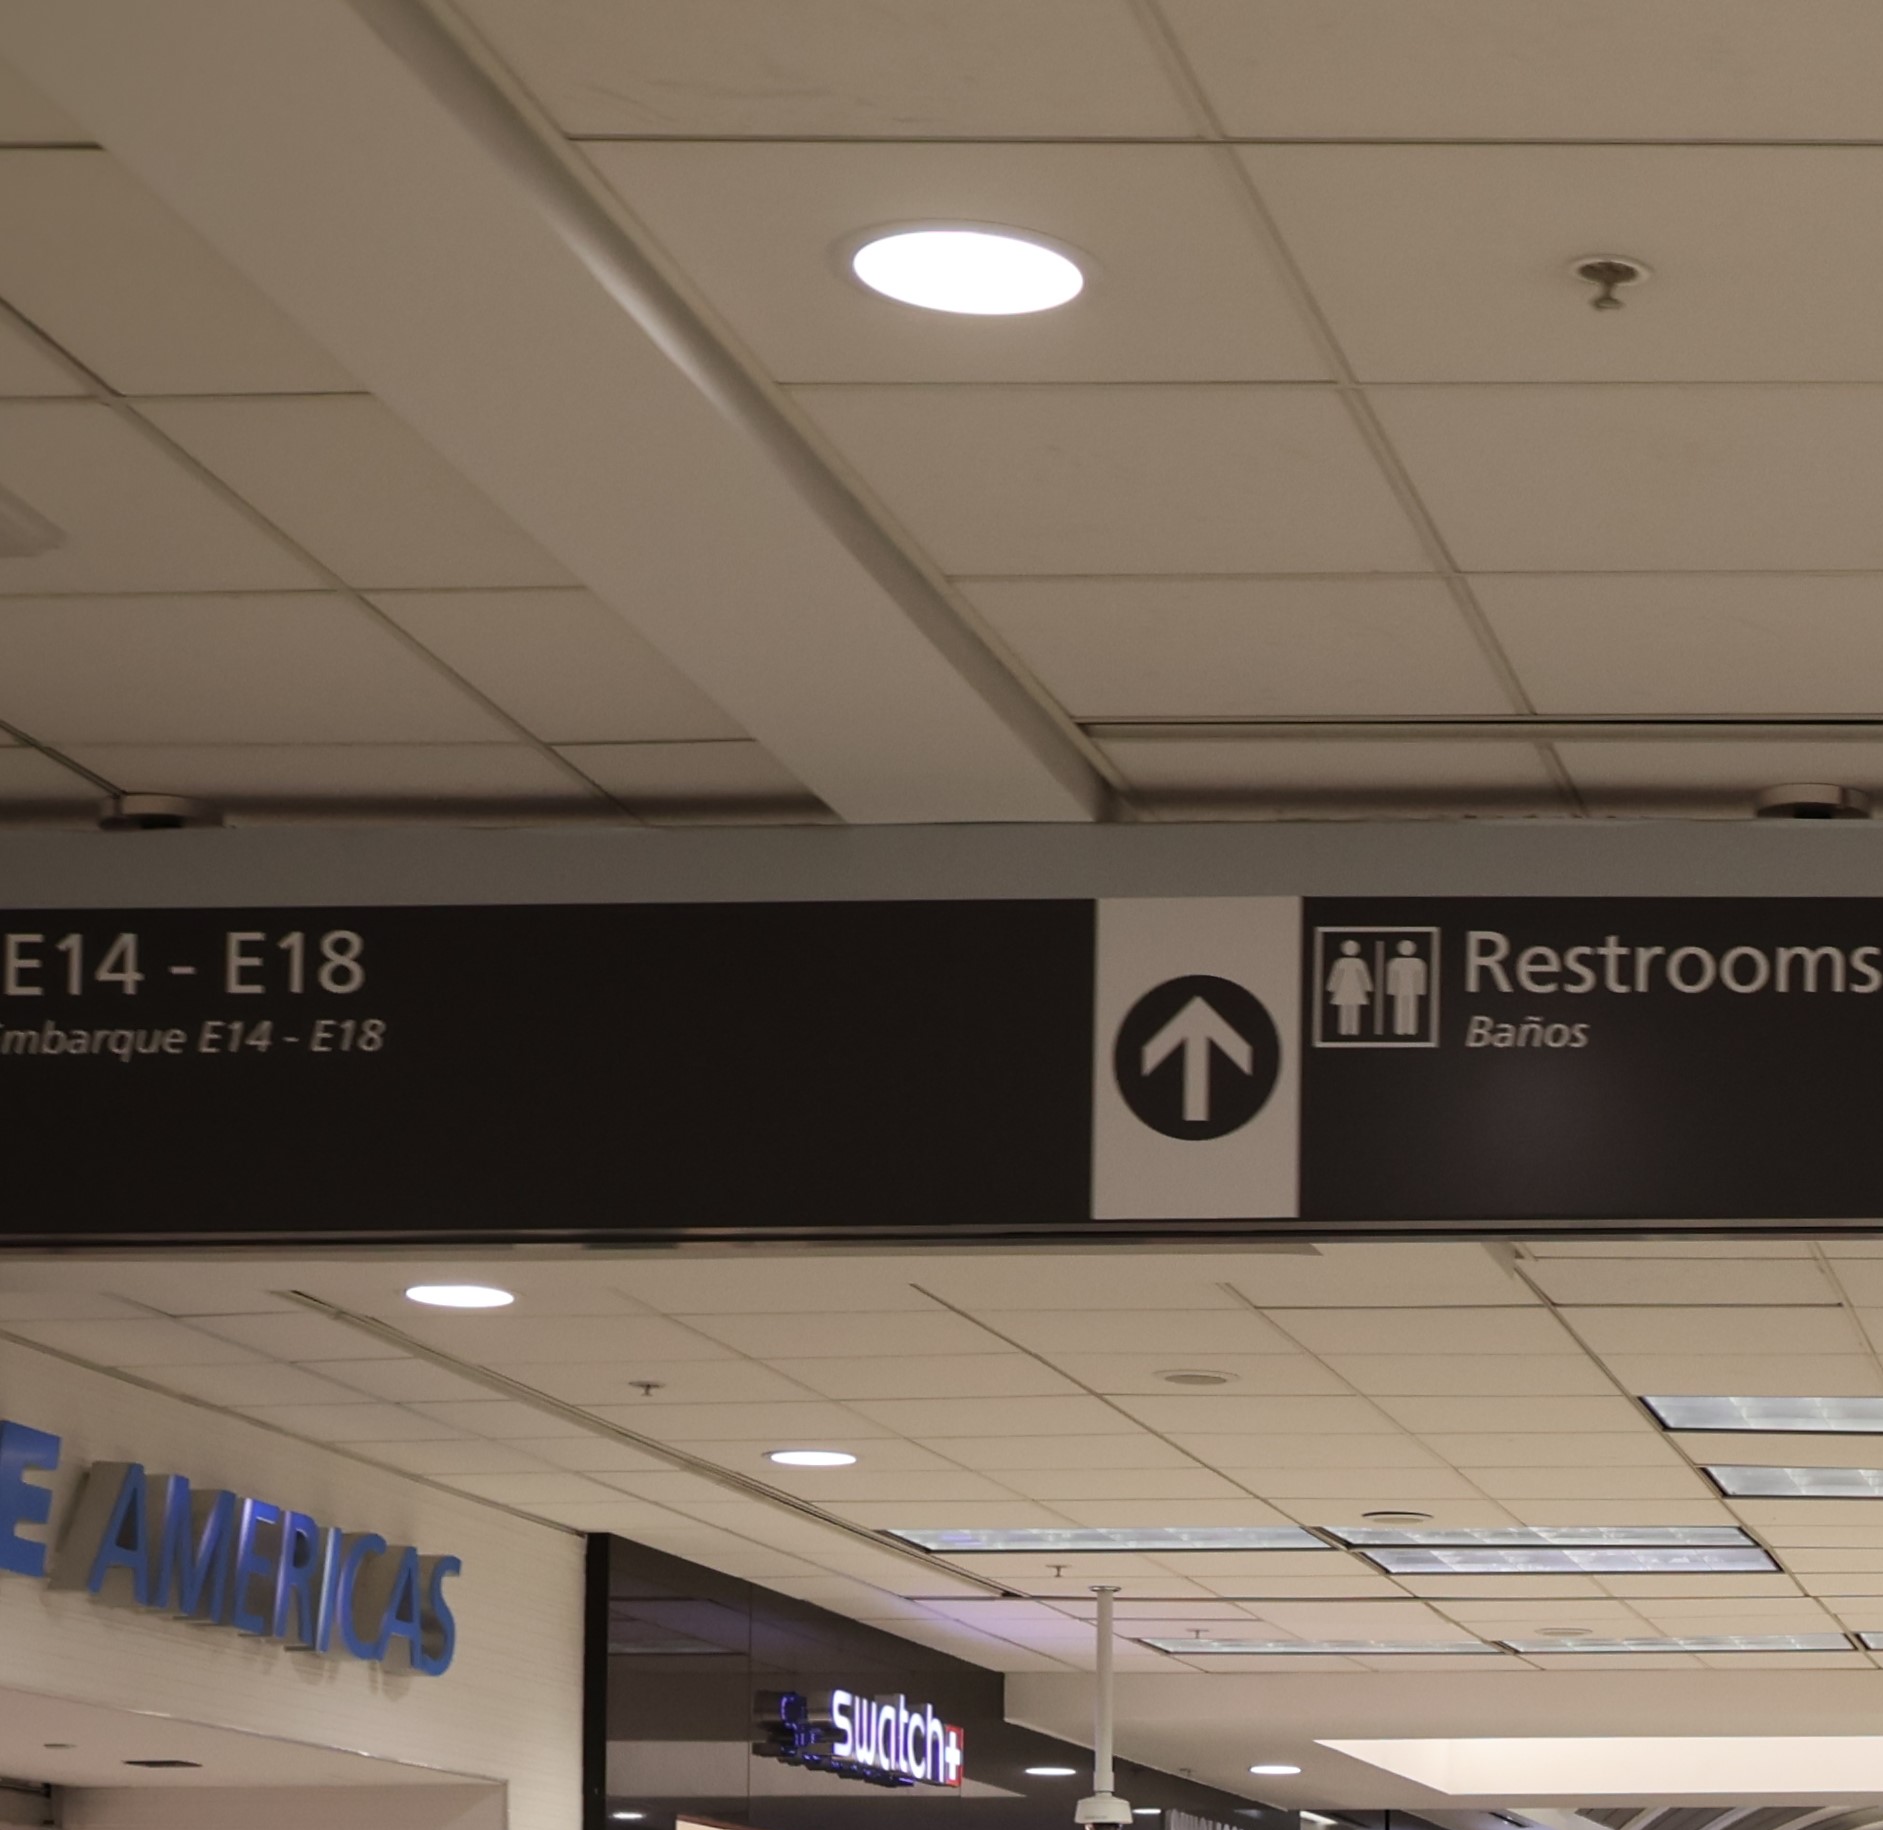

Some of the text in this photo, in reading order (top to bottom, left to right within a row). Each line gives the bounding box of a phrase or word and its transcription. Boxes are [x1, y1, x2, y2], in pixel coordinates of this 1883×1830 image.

[5, 932, 145, 996] E14
[225, 929, 366, 995] E18
[1465, 931, 1883, 994] Restrooms
[0, 1020, 188, 1063] mbarque
[197, 1020, 274, 1054] E14
[309, 1018, 387, 1053] E18
[1465, 1015, 1589, 1049] Baños
[88, 1462, 462, 1677] AMERICAS
[832, 1689, 944, 1783] swatch
